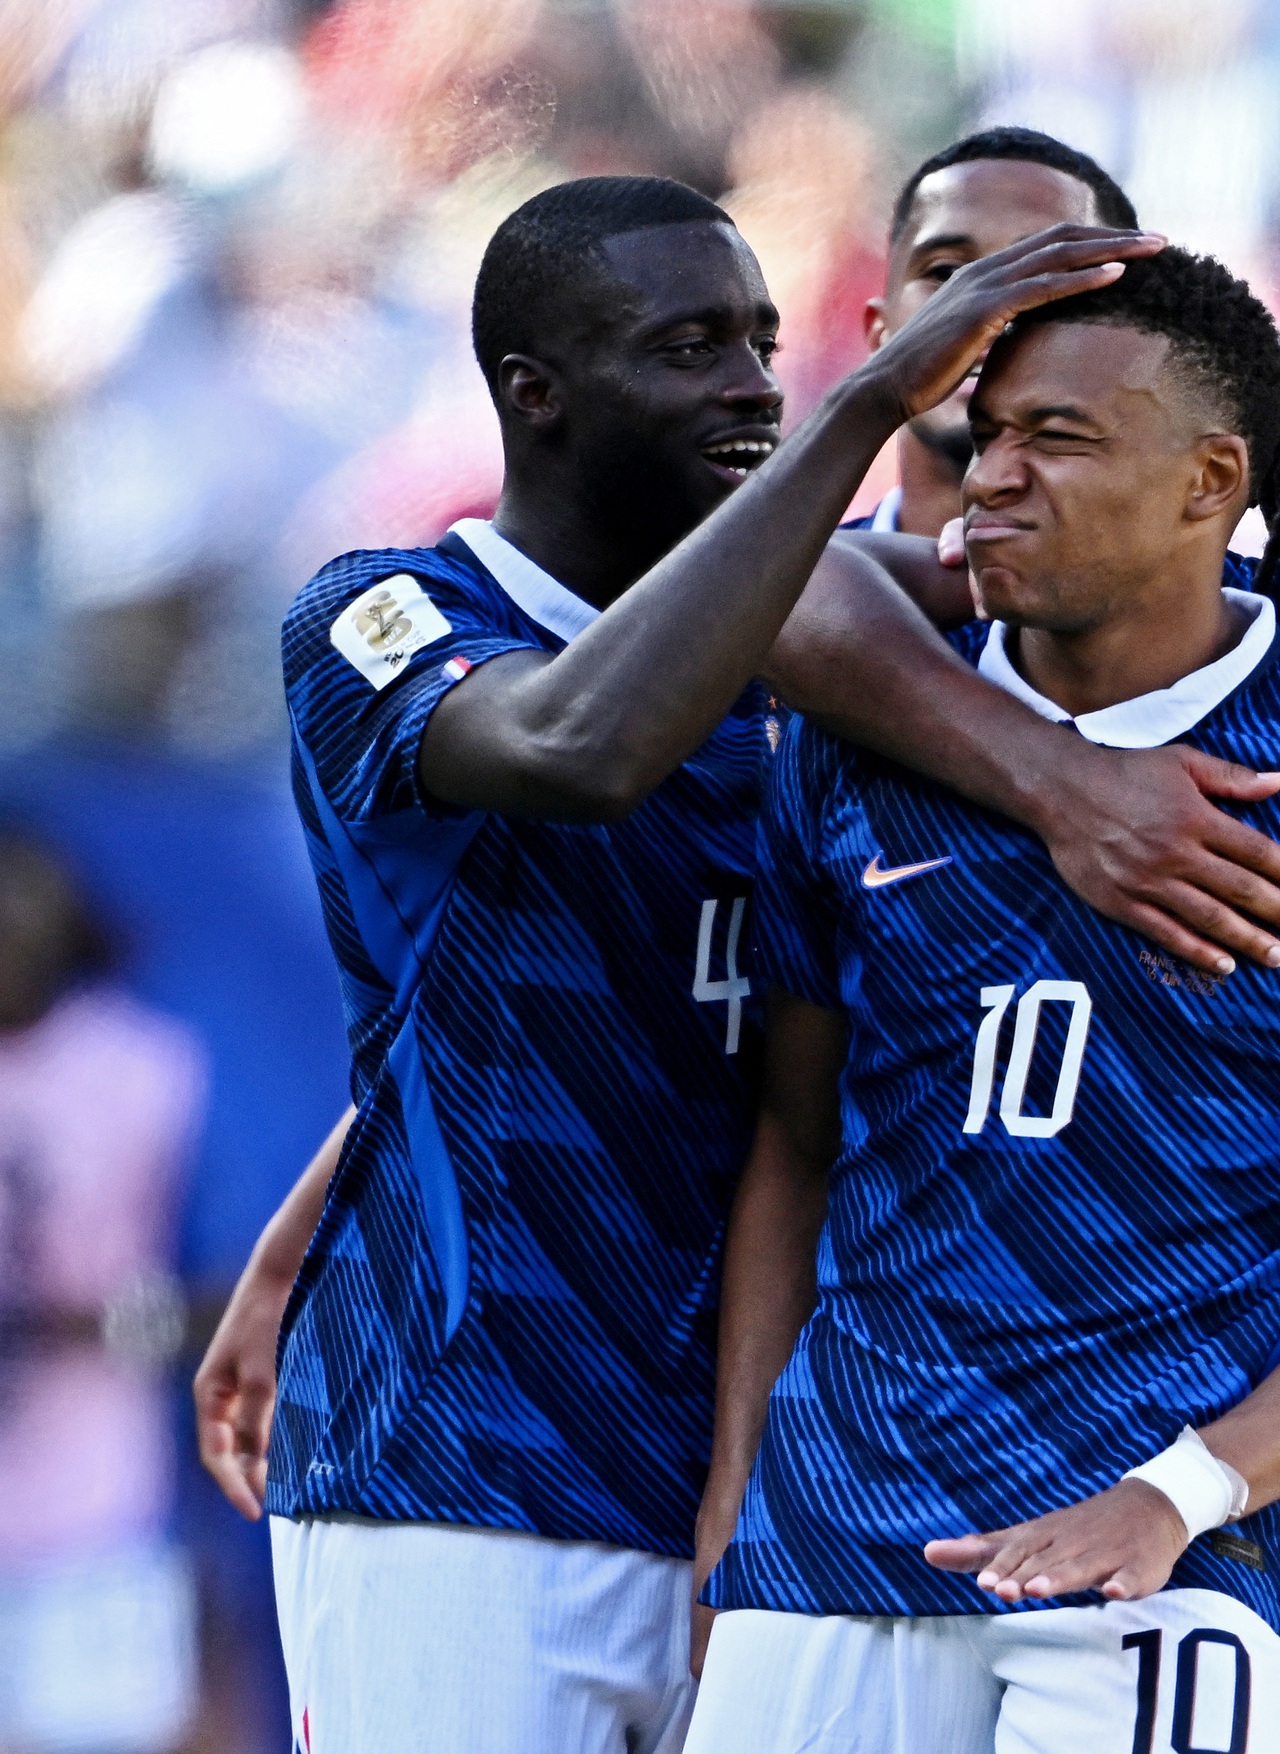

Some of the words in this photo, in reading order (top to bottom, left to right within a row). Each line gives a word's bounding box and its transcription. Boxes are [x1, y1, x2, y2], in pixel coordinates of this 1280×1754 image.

[692, 897, 750, 1054] 4
[963, 979, 1092, 1138] 10
[1121, 1627, 1251, 1754] 10
